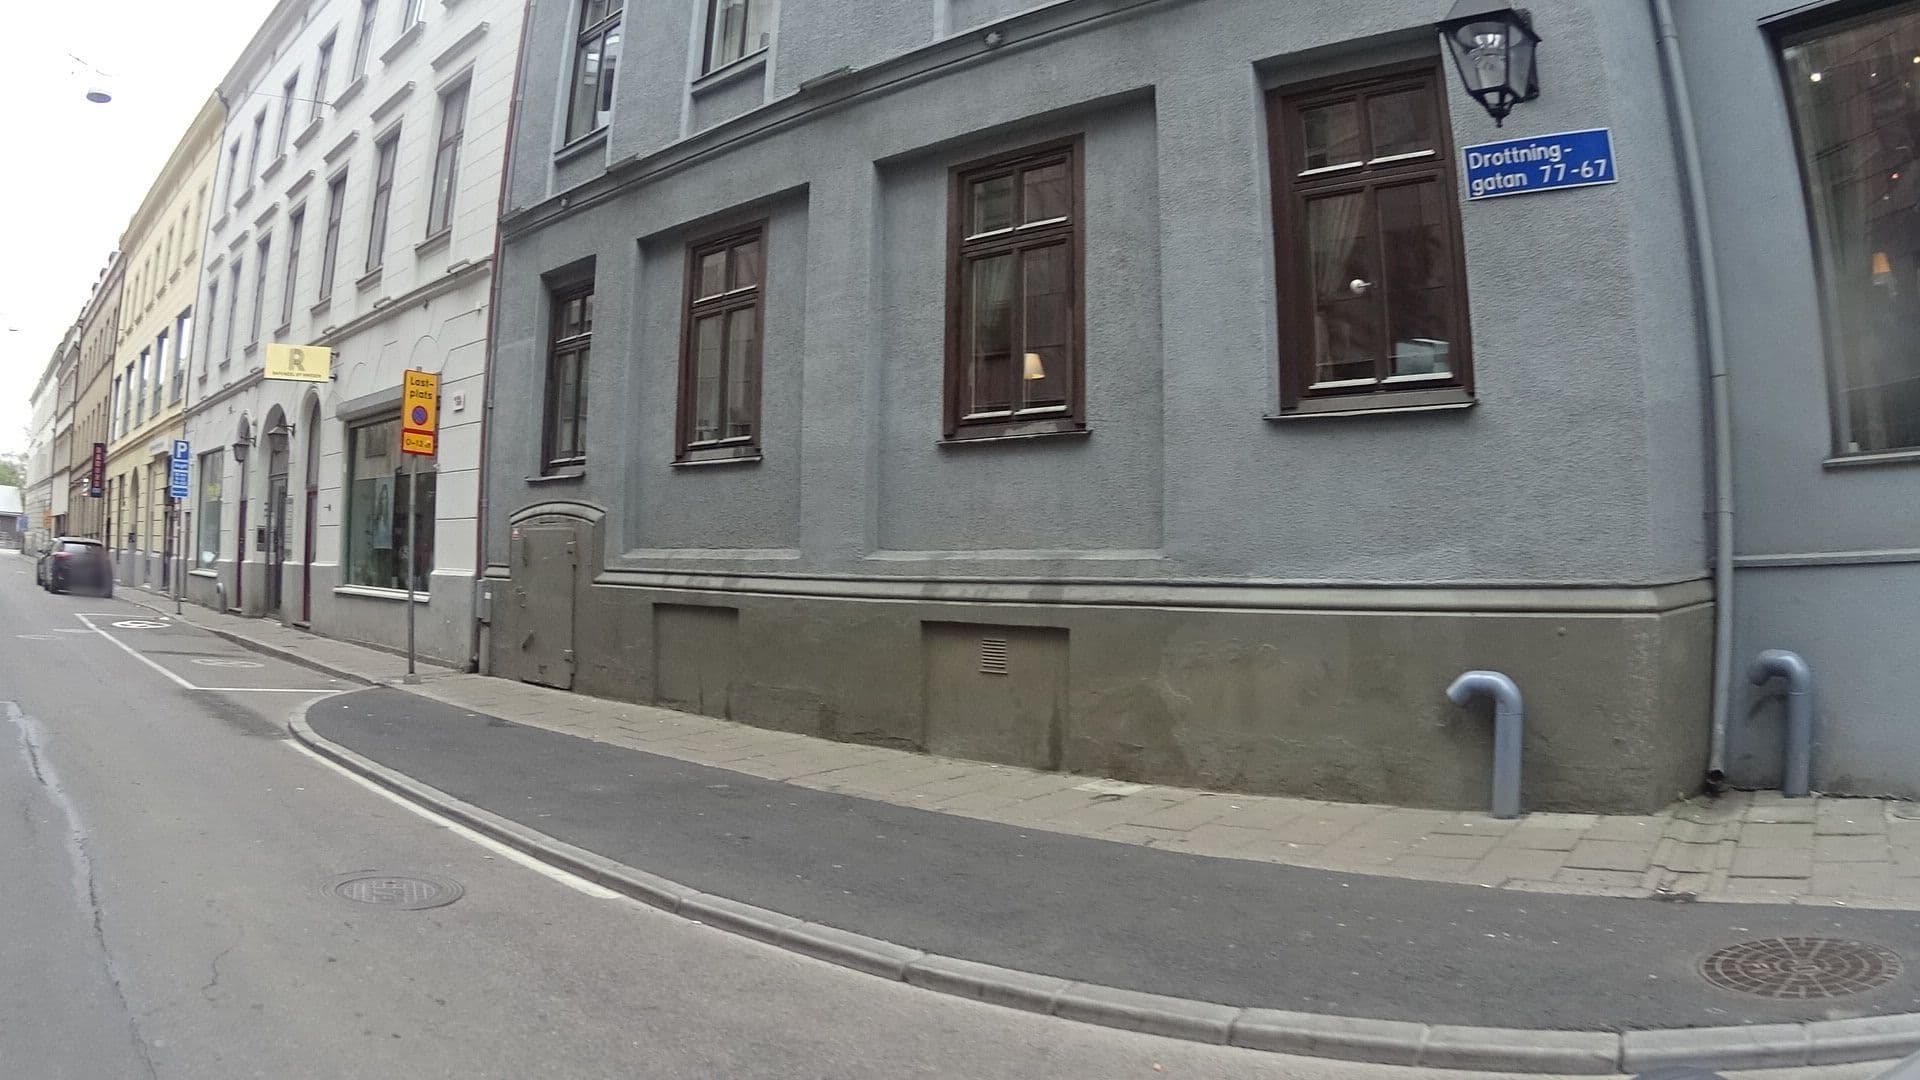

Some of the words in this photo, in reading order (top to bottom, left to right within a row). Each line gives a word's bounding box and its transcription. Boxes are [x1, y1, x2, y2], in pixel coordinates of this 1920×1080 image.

[1468, 143, 1573, 170] Drottning-
[1471, 172, 1528, 196] gatan
[1539, 159, 1607, 183] 77-67
[288, 348, 305, 371] R
[409, 376, 434, 387] Last-
[409, 389, 433, 400] plats
[176, 441, 188, 458] P
